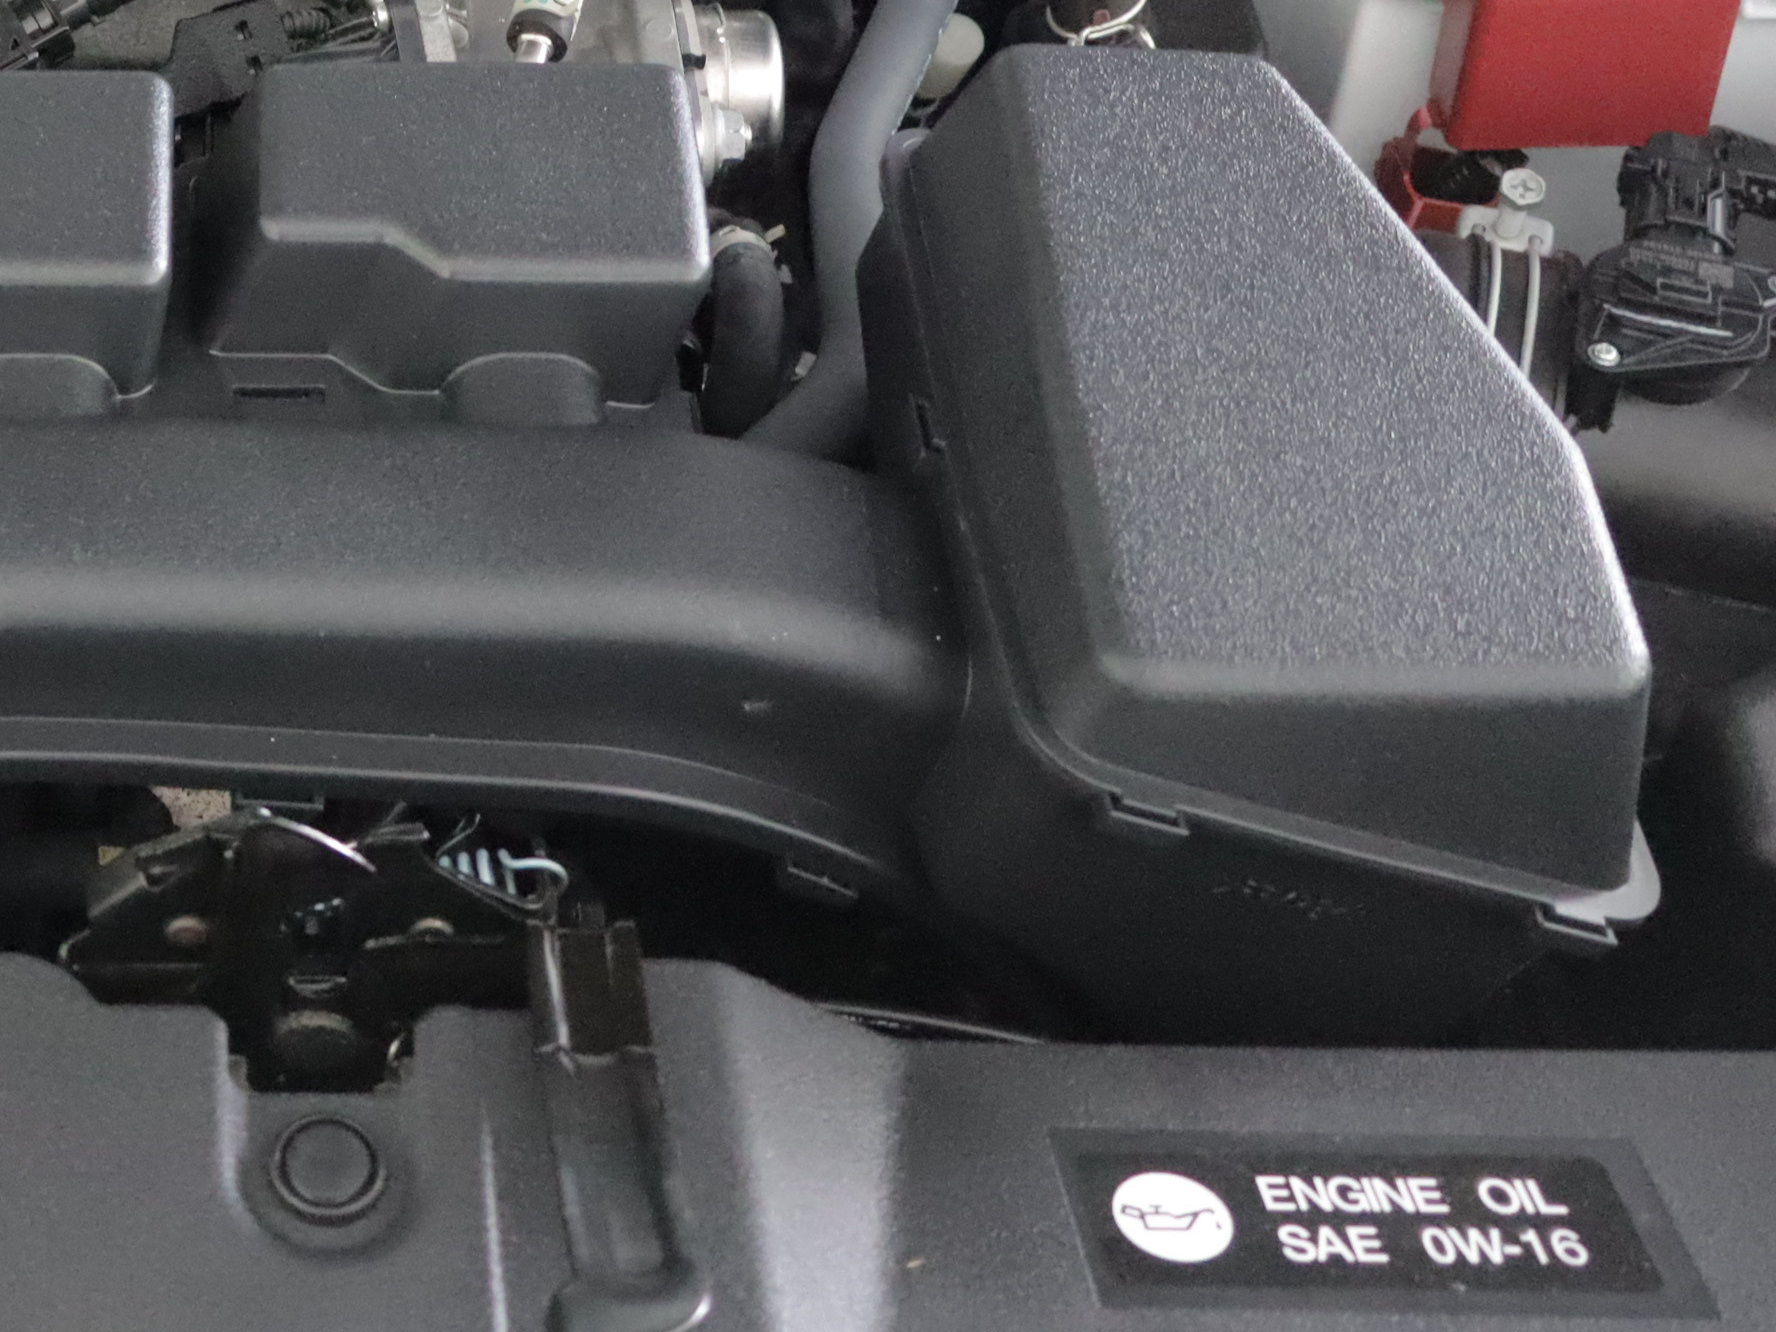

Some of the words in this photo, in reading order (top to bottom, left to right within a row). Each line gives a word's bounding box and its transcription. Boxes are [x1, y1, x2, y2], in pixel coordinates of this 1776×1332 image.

[1255, 1175, 1450, 1215] ENGINE
[1477, 1177, 1569, 1216] OIL
[1278, 1225, 1390, 1264] SAE
[1422, 1228, 1590, 1267] 0W-16
